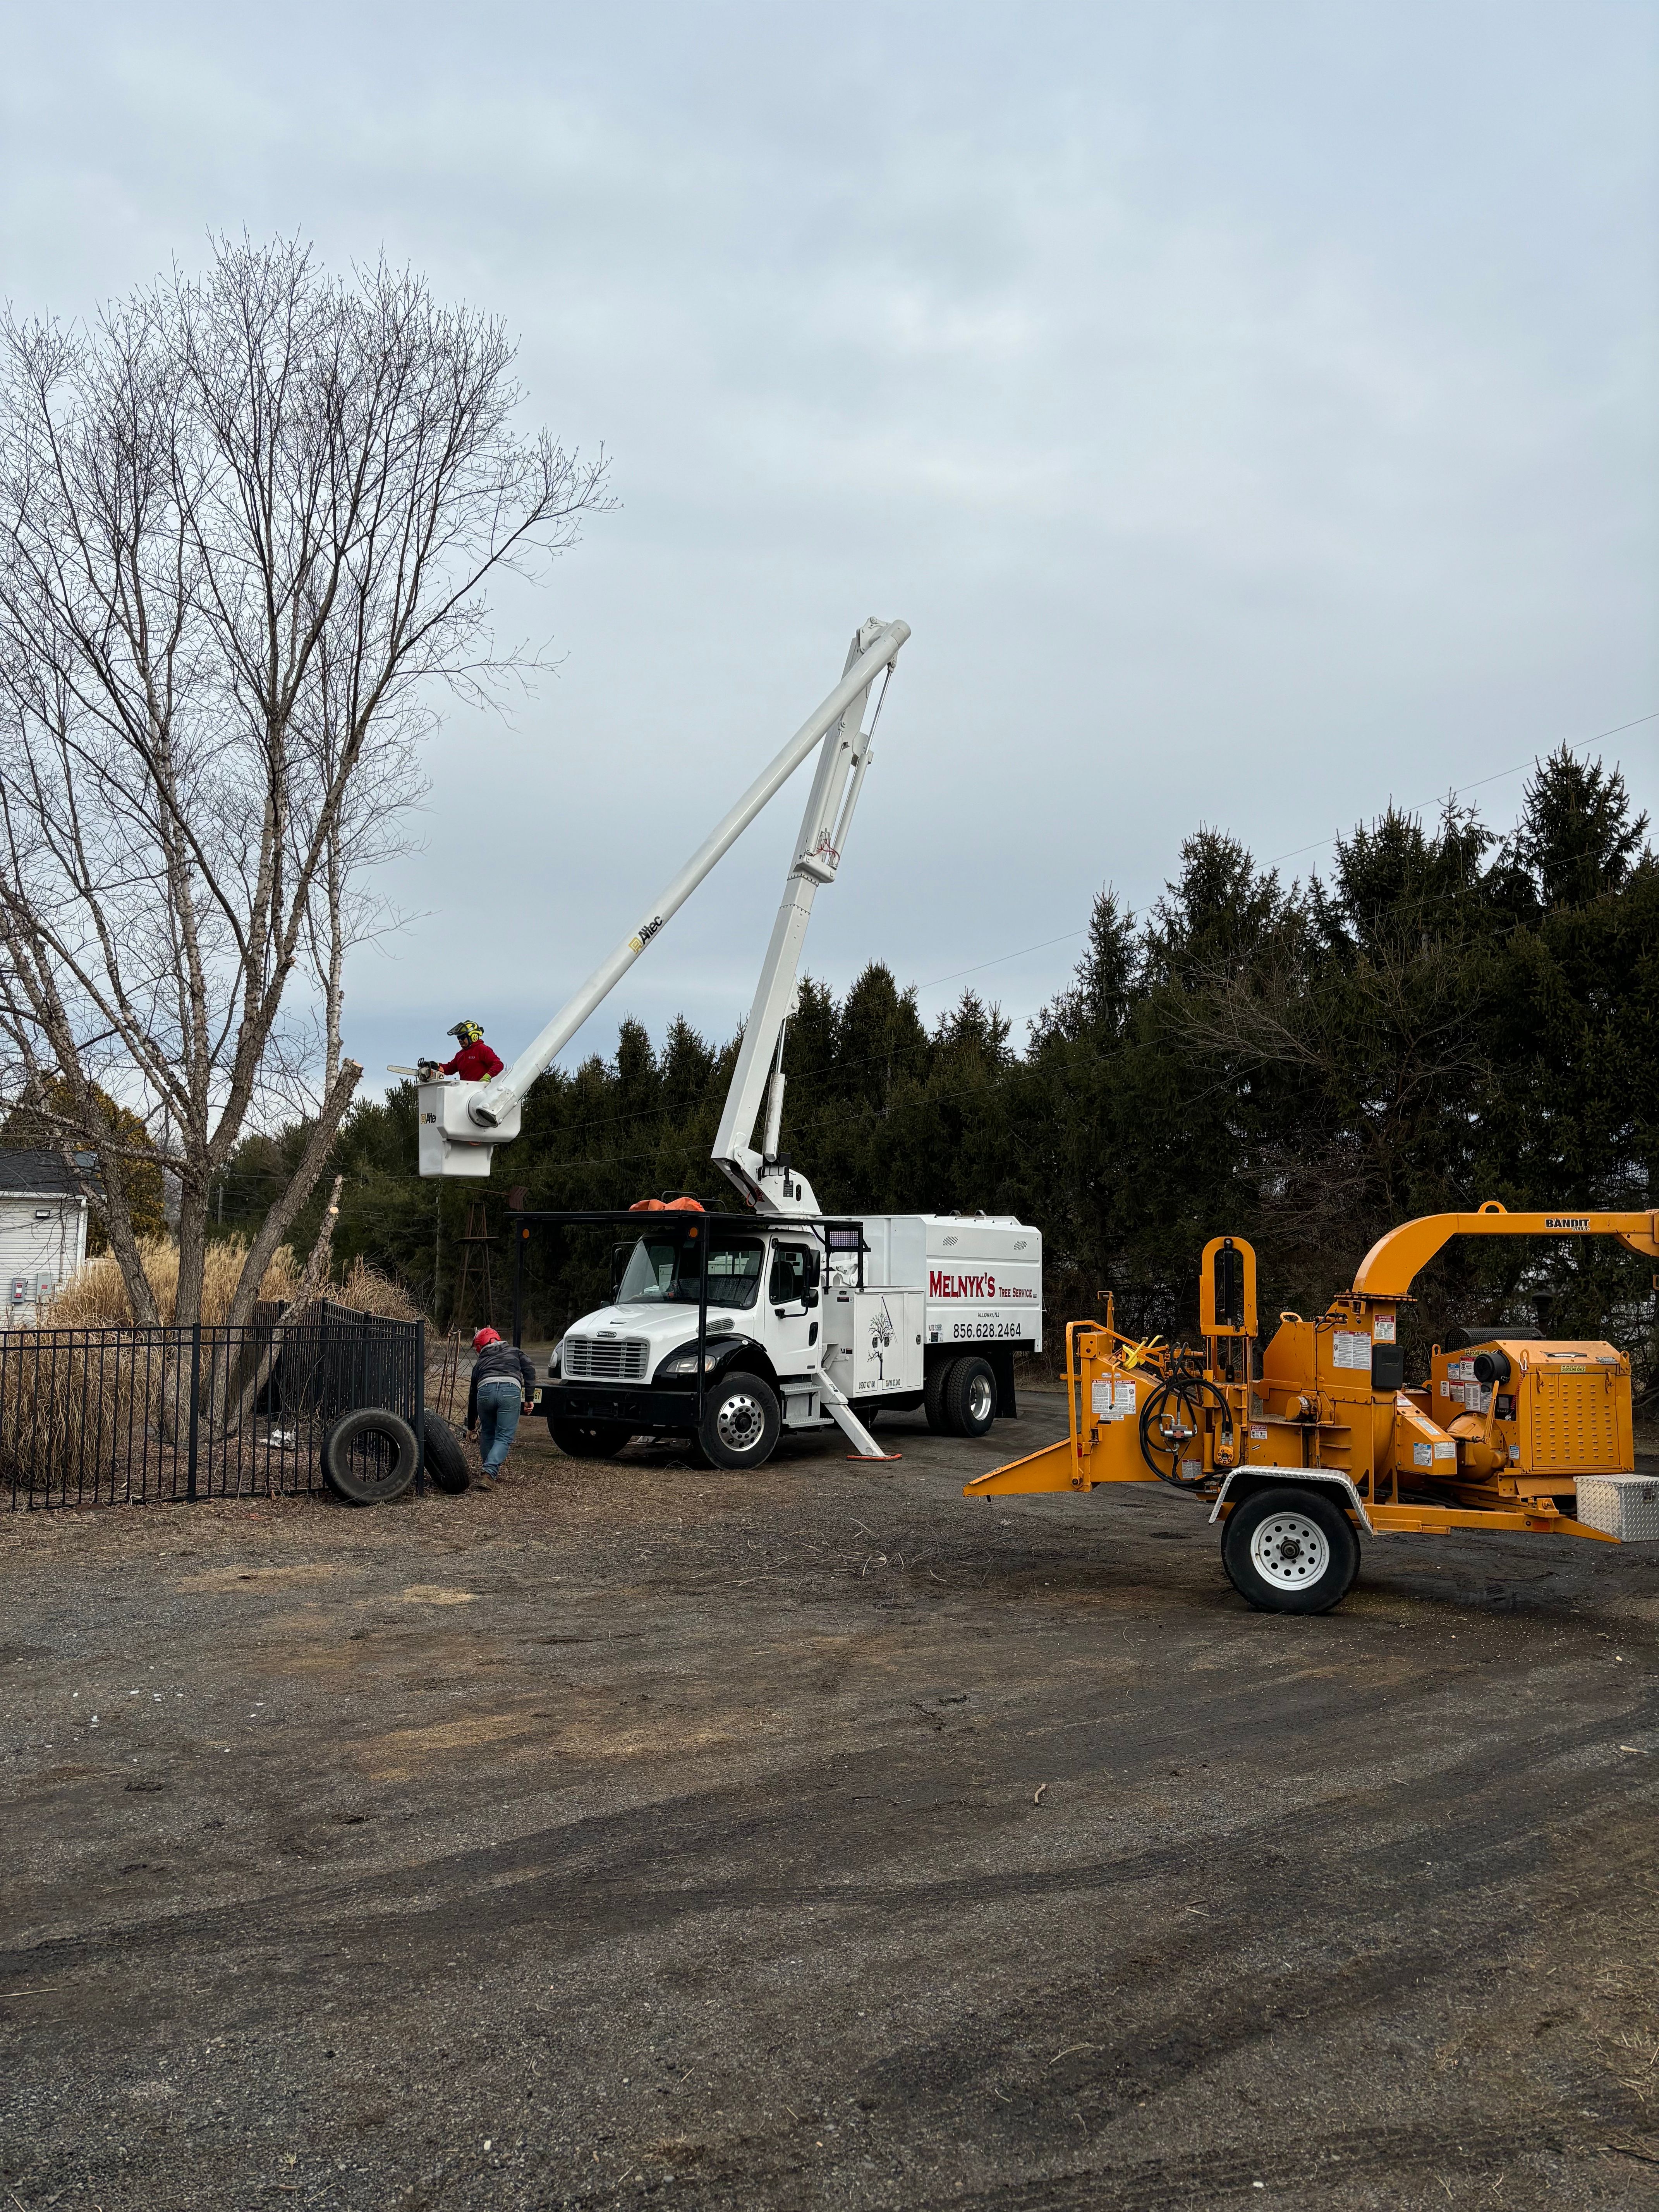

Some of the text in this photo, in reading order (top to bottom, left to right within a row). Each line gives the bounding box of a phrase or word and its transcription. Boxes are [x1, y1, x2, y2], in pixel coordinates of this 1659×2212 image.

[638, 916, 663, 945] Altec
[426, 1112, 436, 1124] Alte
[1546, 1219, 1589, 1228] BANDIT
[929, 1271, 995, 1298] MELNYK'S
[998, 1287, 1011, 1298] TREE
[1012, 1287, 1032, 1298] SERVICE
[953, 1323, 1021, 1338] 856.628.2464
